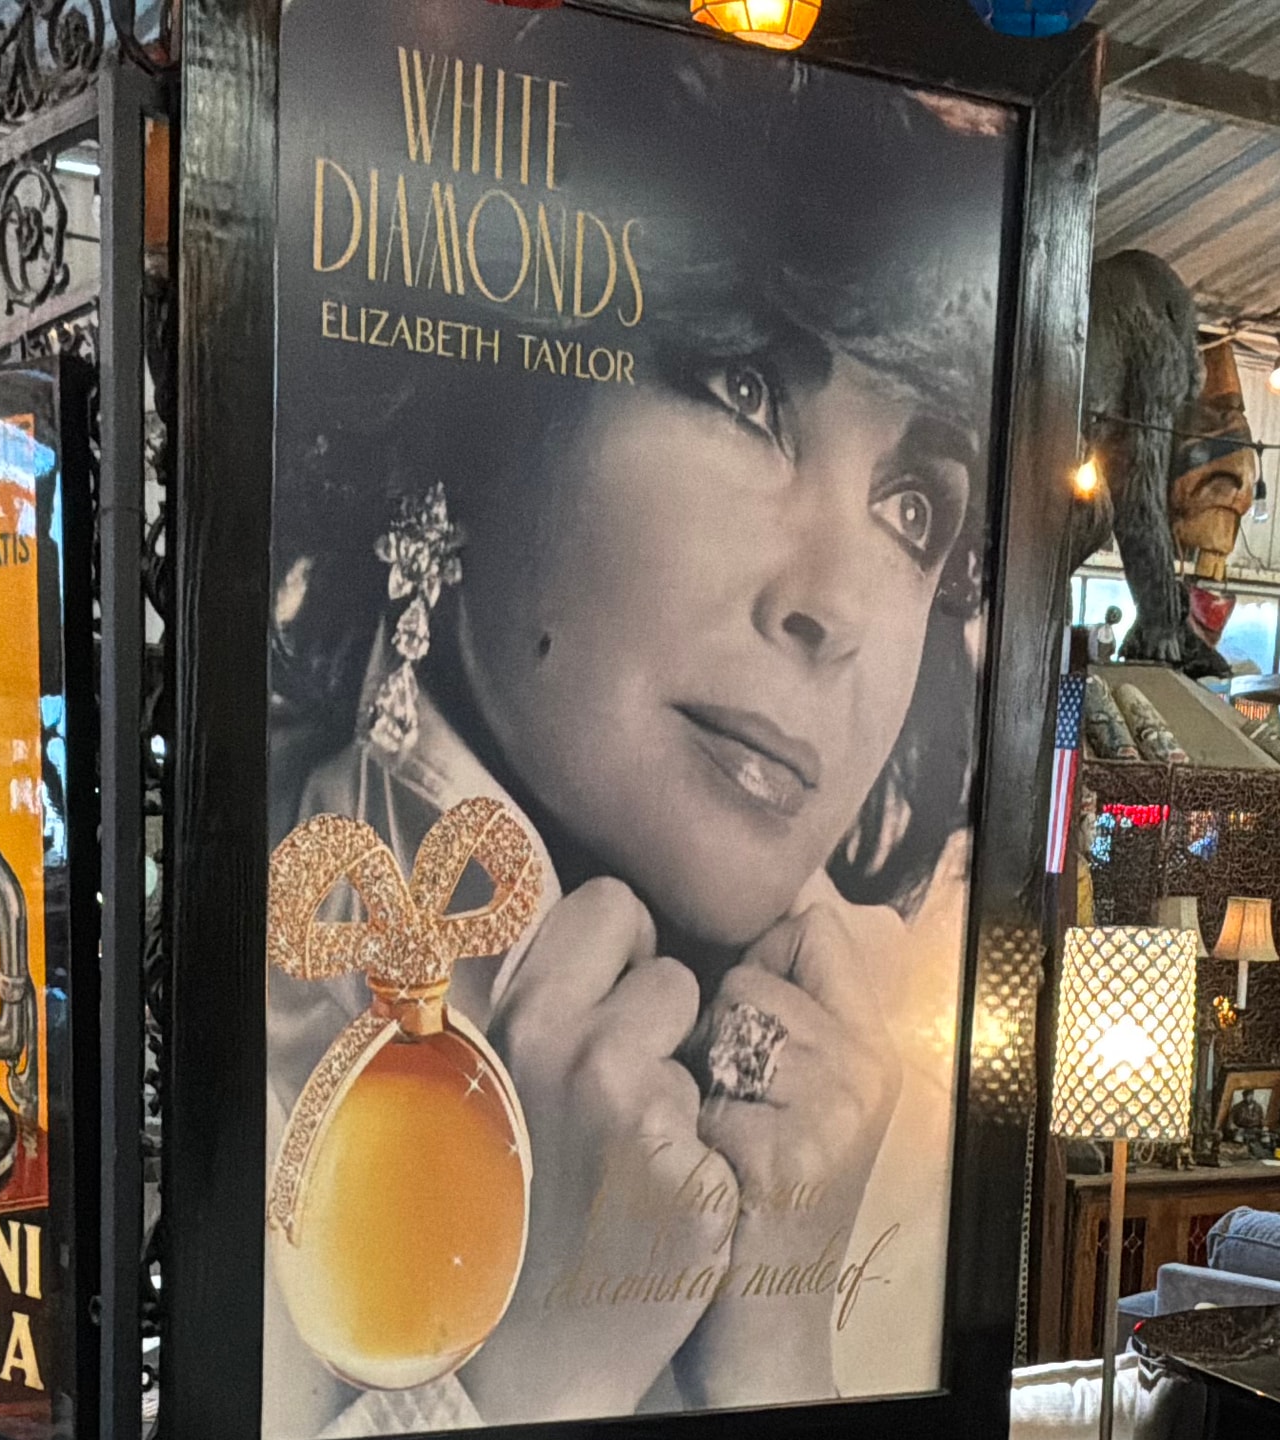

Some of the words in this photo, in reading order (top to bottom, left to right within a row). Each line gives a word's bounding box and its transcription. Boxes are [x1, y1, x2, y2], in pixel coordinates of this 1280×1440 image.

[397, 46, 572, 191] WHITE
[313, 157, 644, 328] DIAMONDS
[322, 299, 500, 365] ELIZABETH
[517, 333, 635, 385] TAYLOR
[741, 1225, 841, 1298] made
